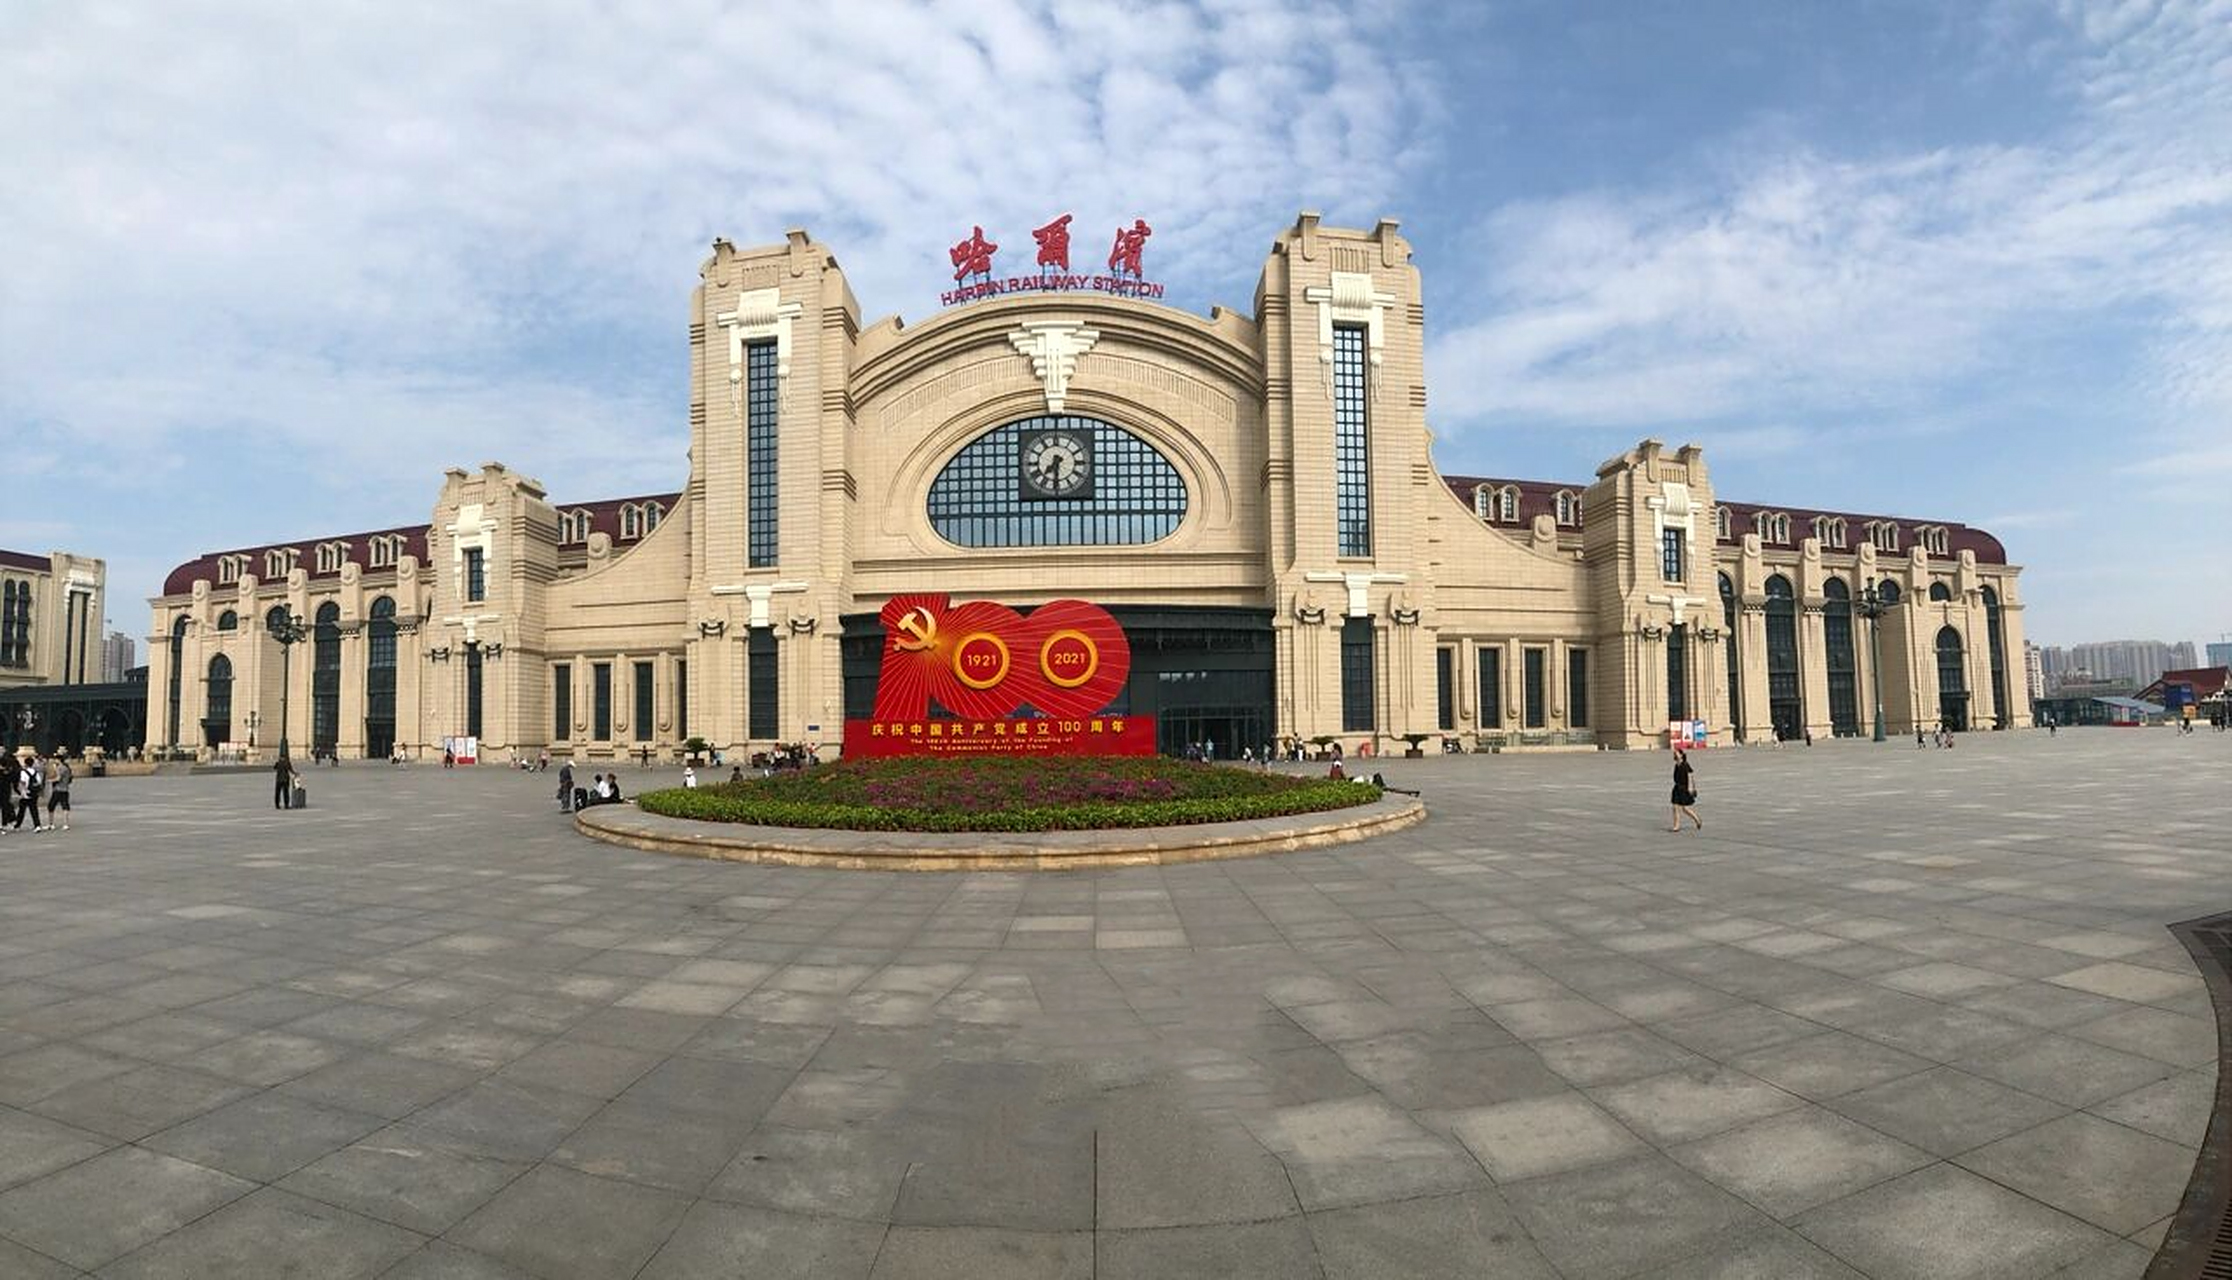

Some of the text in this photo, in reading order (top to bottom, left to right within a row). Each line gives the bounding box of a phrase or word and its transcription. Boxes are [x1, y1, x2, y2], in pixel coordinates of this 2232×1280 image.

[941, 275, 1164, 306] HARBIN RAILWAY STATION
[967, 654, 997, 667] 1921
[1054, 653, 1085, 665] 2021
